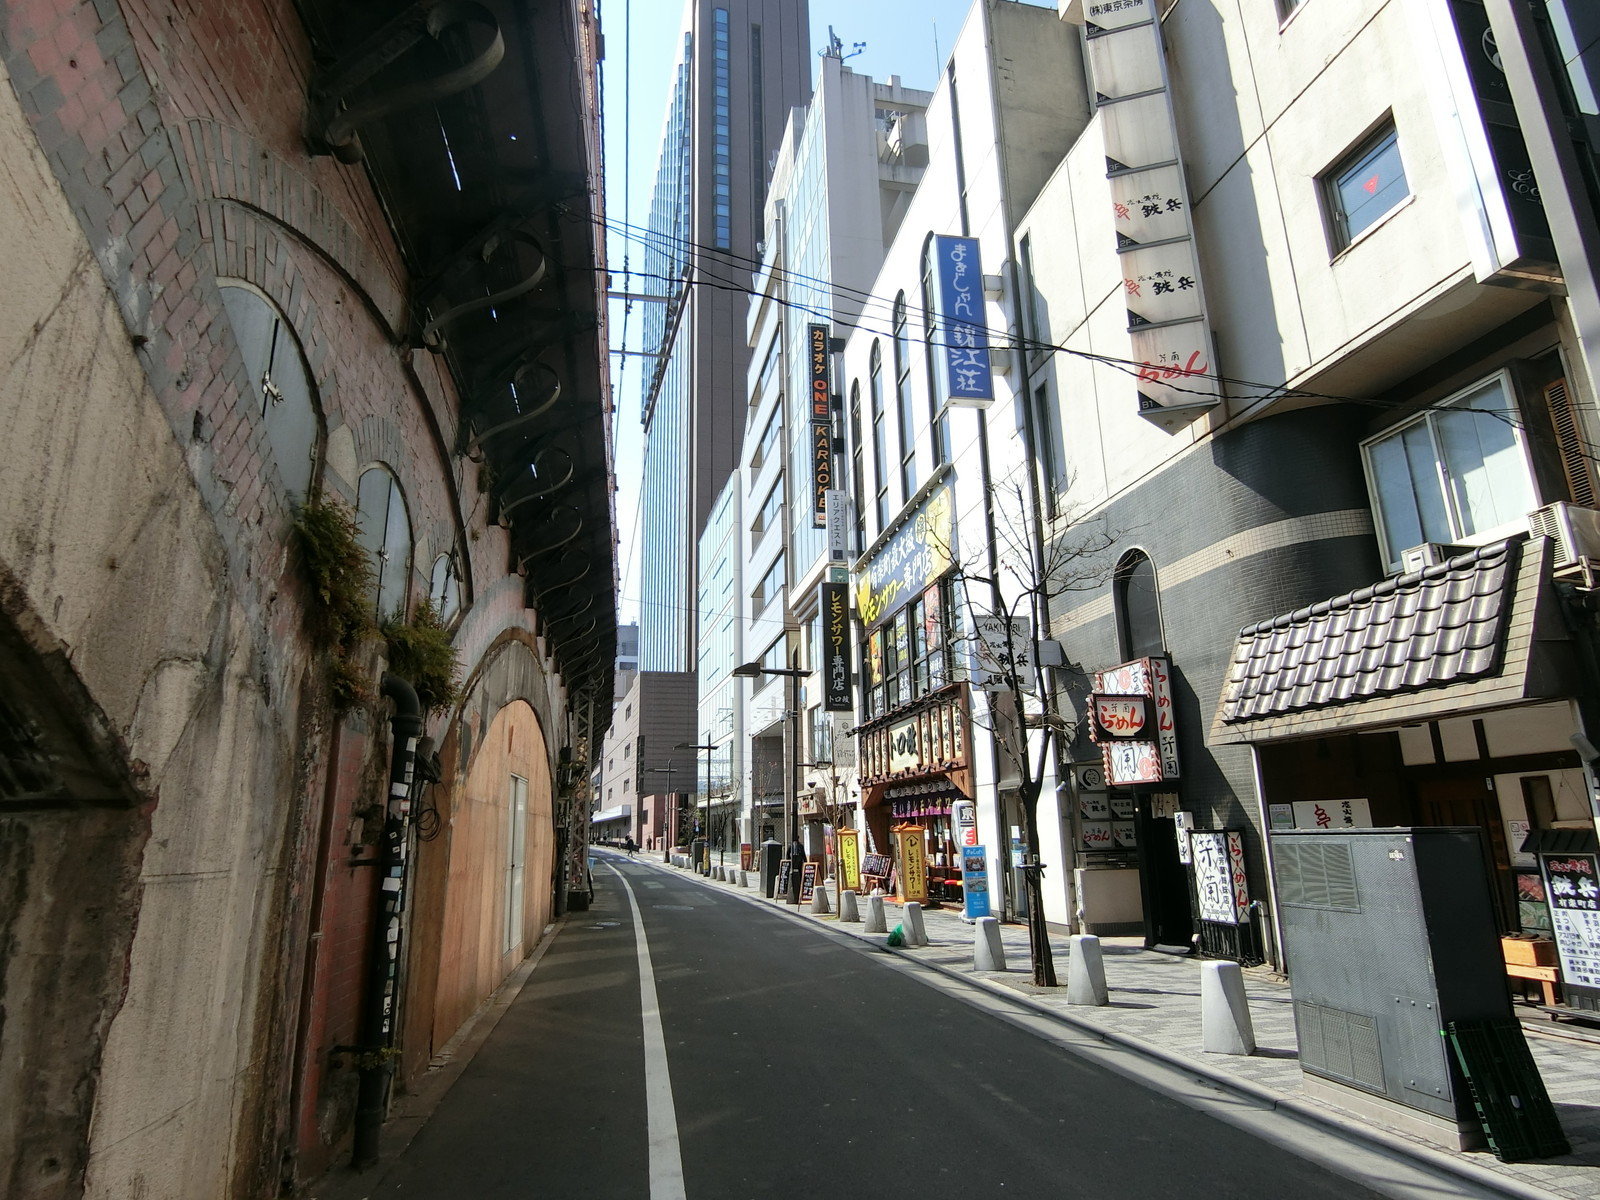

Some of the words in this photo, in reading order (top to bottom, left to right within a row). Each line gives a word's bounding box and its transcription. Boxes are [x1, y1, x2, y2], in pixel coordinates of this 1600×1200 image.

[1108, 163, 1120, 172] 3F
[1120, 238, 1131, 247] 2F
[1132, 317, 1142, 325] 1F
[813, 329, 825, 374] カラオケ
[813, 379, 828, 415] ONE
[1142, 400, 1153, 408] B1
[815, 426, 830, 509] KARAOKE
[833, 494, 841, 547] エリアクエスト
[830, 590, 845, 691] レモンサワー専門店
[983, 623, 1021, 632] YAKITRI
[1155, 661, 1173, 731] らーめん
[1101, 706, 1143, 732] らーめん
[1231, 838, 1248, 907] らーめん
